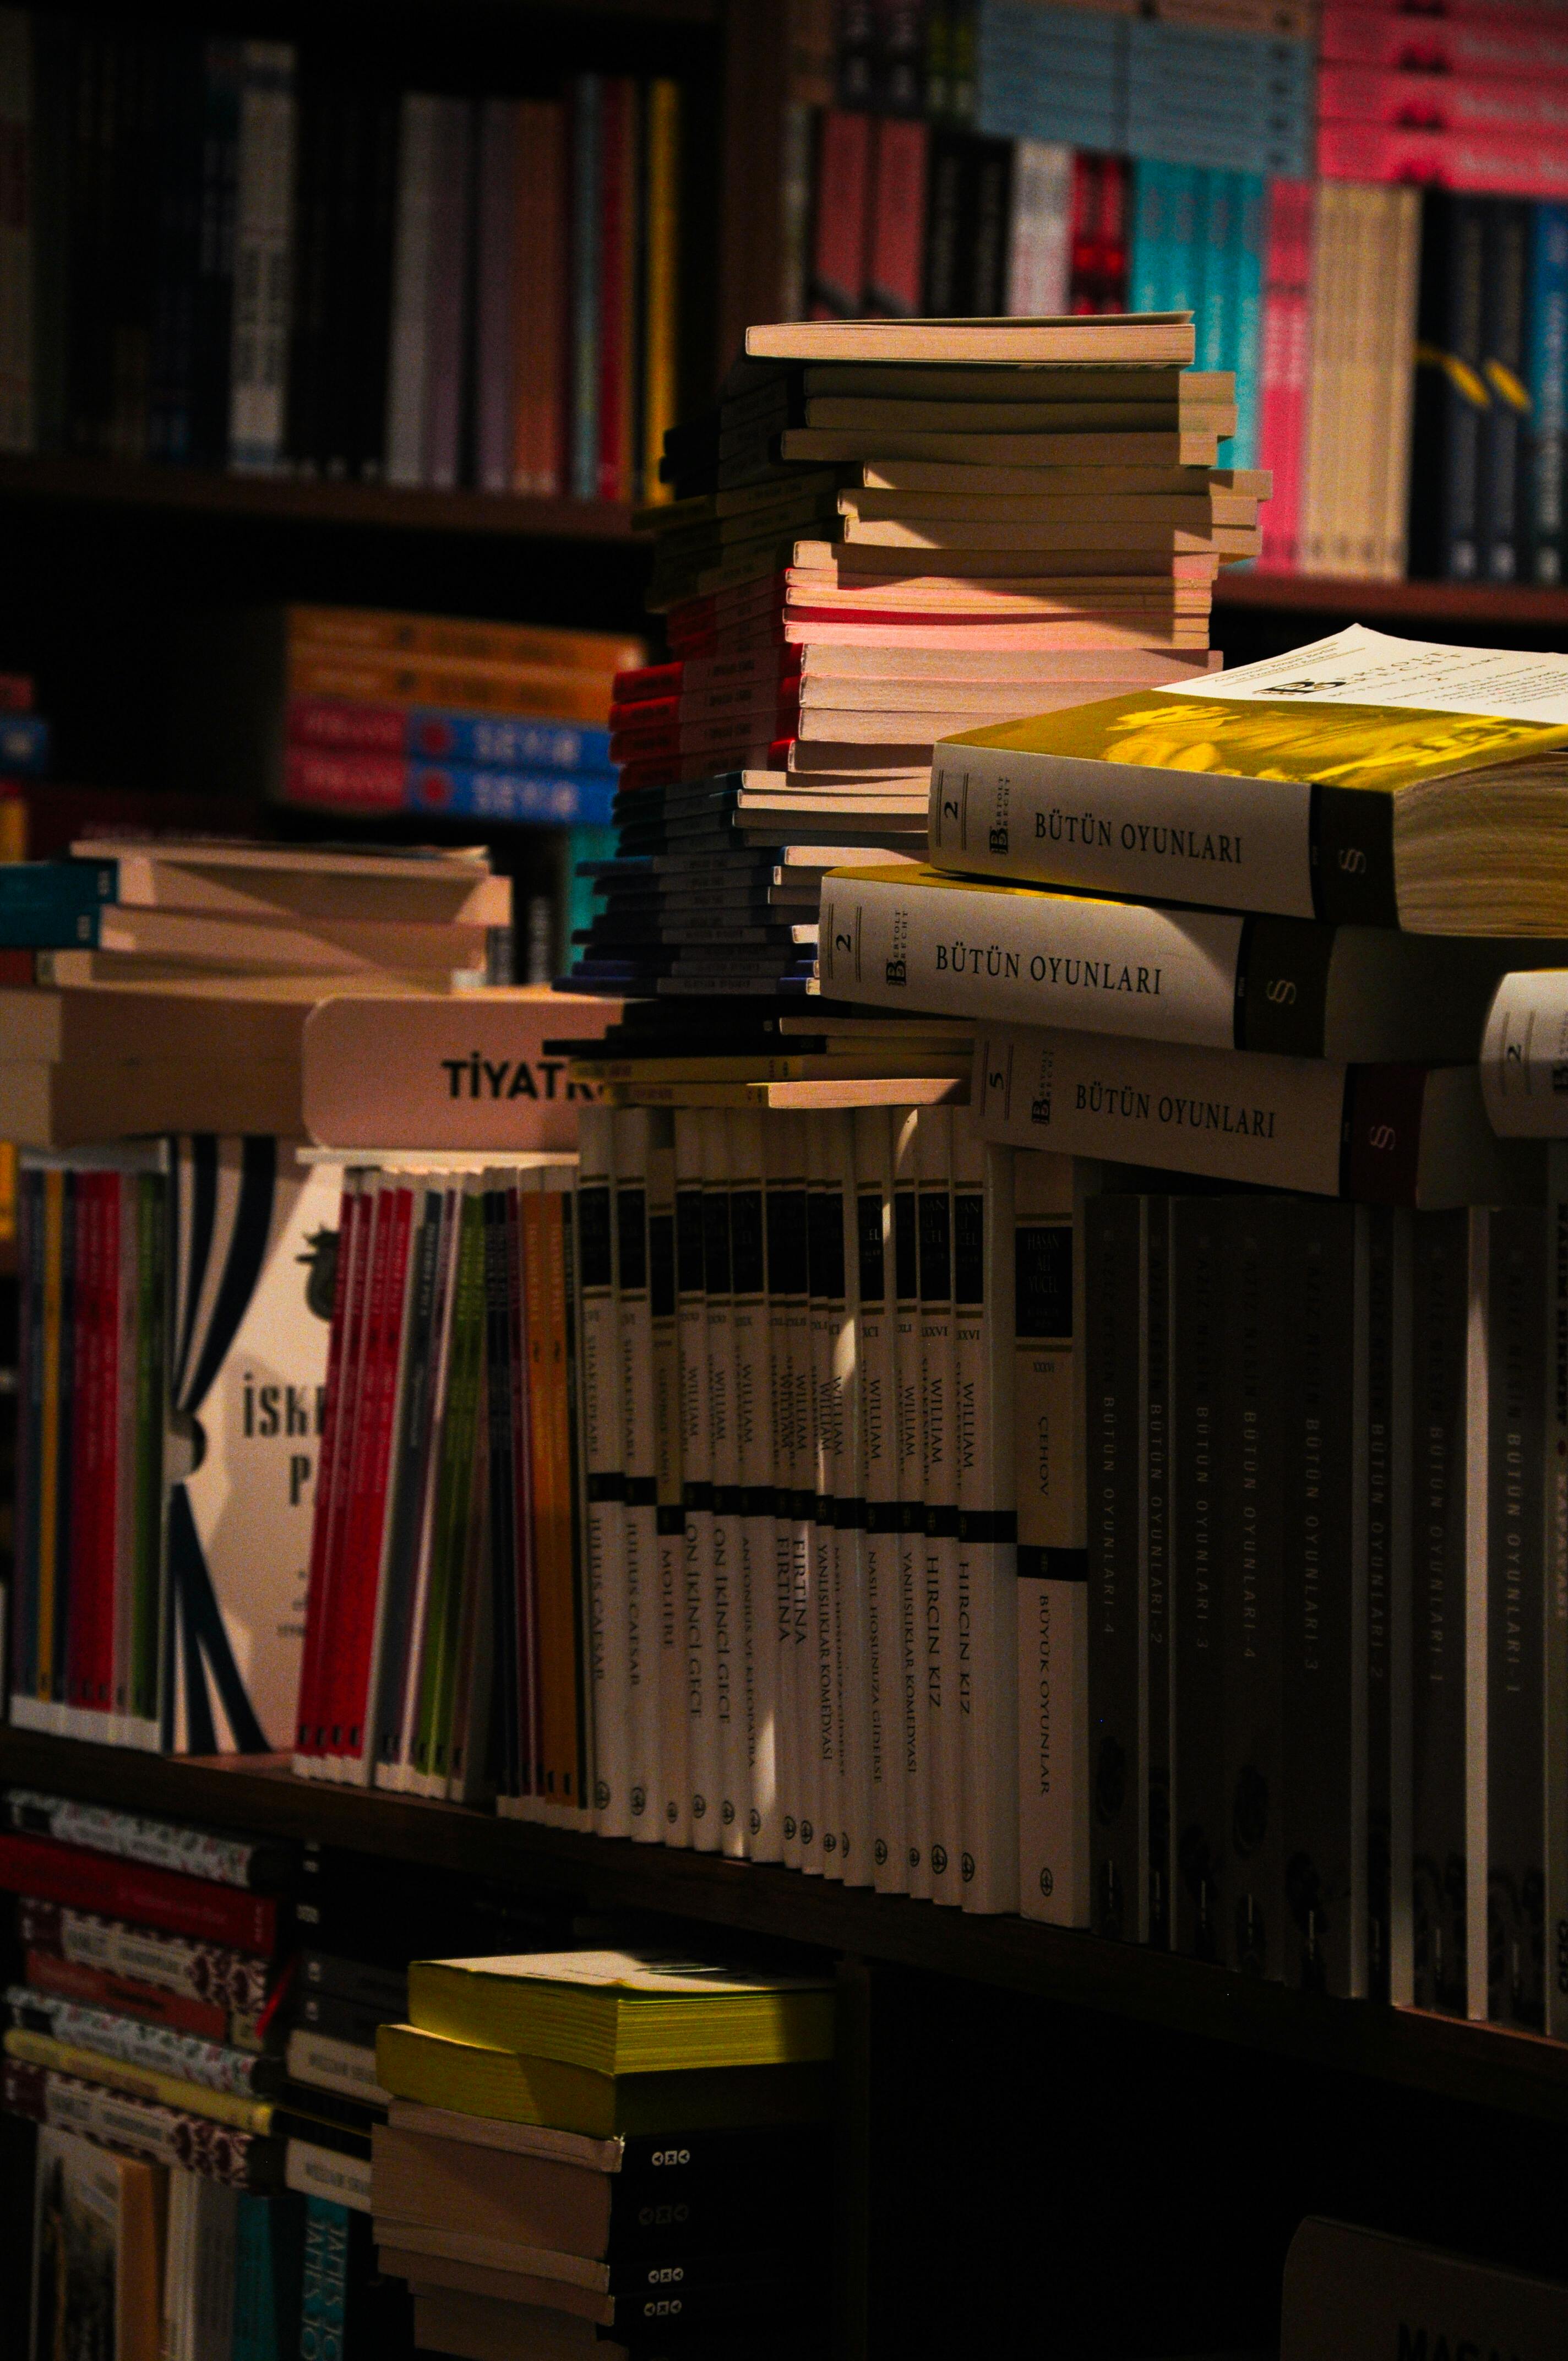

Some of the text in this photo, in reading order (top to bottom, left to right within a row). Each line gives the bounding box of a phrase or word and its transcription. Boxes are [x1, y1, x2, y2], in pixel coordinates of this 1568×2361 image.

[944, 801, 959, 820] 2
[1034, 807, 1243, 865] BÜTÜN OYUNLARI
[835, 933, 852, 953] 2
[936, 941, 1163, 996] BÜTÜN OYUNLARI
[442, 1051, 602, 1099] TİYAT
[1506, 1044, 1521, 1063] 2
[1075, 1085, 1276, 1139] BÜTÜN OYUNLARI
[795, 1374, 808, 1450] WILLIAM
[819, 1383, 832, 1451] WILLIAM
[832, 1377, 843, 1456] WILLIAM
[870, 1379, 881, 1459] WILLIAM
[904, 1386, 915, 1457] WILLIAM
[931, 1378, 943, 1464] WILLIAM
[963, 1383, 974, 1468] WILLIAM
[1103, 1397, 1116, 1472] BÜTÜN
[1150, 1404, 1163, 1480] BÜTÜN
[1195, 1407, 1211, 1483] BÜTÜN
[1243, 1411, 1257, 1491] BÜTÜN
[1305, 1419, 1321, 1499] BÜTÜN
[1370, 1424, 1385, 1504] BÜTÜN
[1429, 1427, 1445, 1509] BÜTÜN
[1505, 1433, 1522, 1516] BÜTÜN
[685, 1524, 699, 1562] ON
[714, 1527, 726, 1566] ON
[868, 1551, 878, 1599] NASIL
[777, 1538, 791, 1642] FIRTINA
[793, 1540, 808, 1645] FIRTINA
[820, 1664, 832, 1760] KOMEDYASI
[905, 1674, 917, 1773] KOMEDYASI
[929, 1666, 941, 1709] KIZ
[960, 1672, 970, 1716] KIZ
[1039, 1594, 1050, 1796] BÜYÜK OYUNLAR
